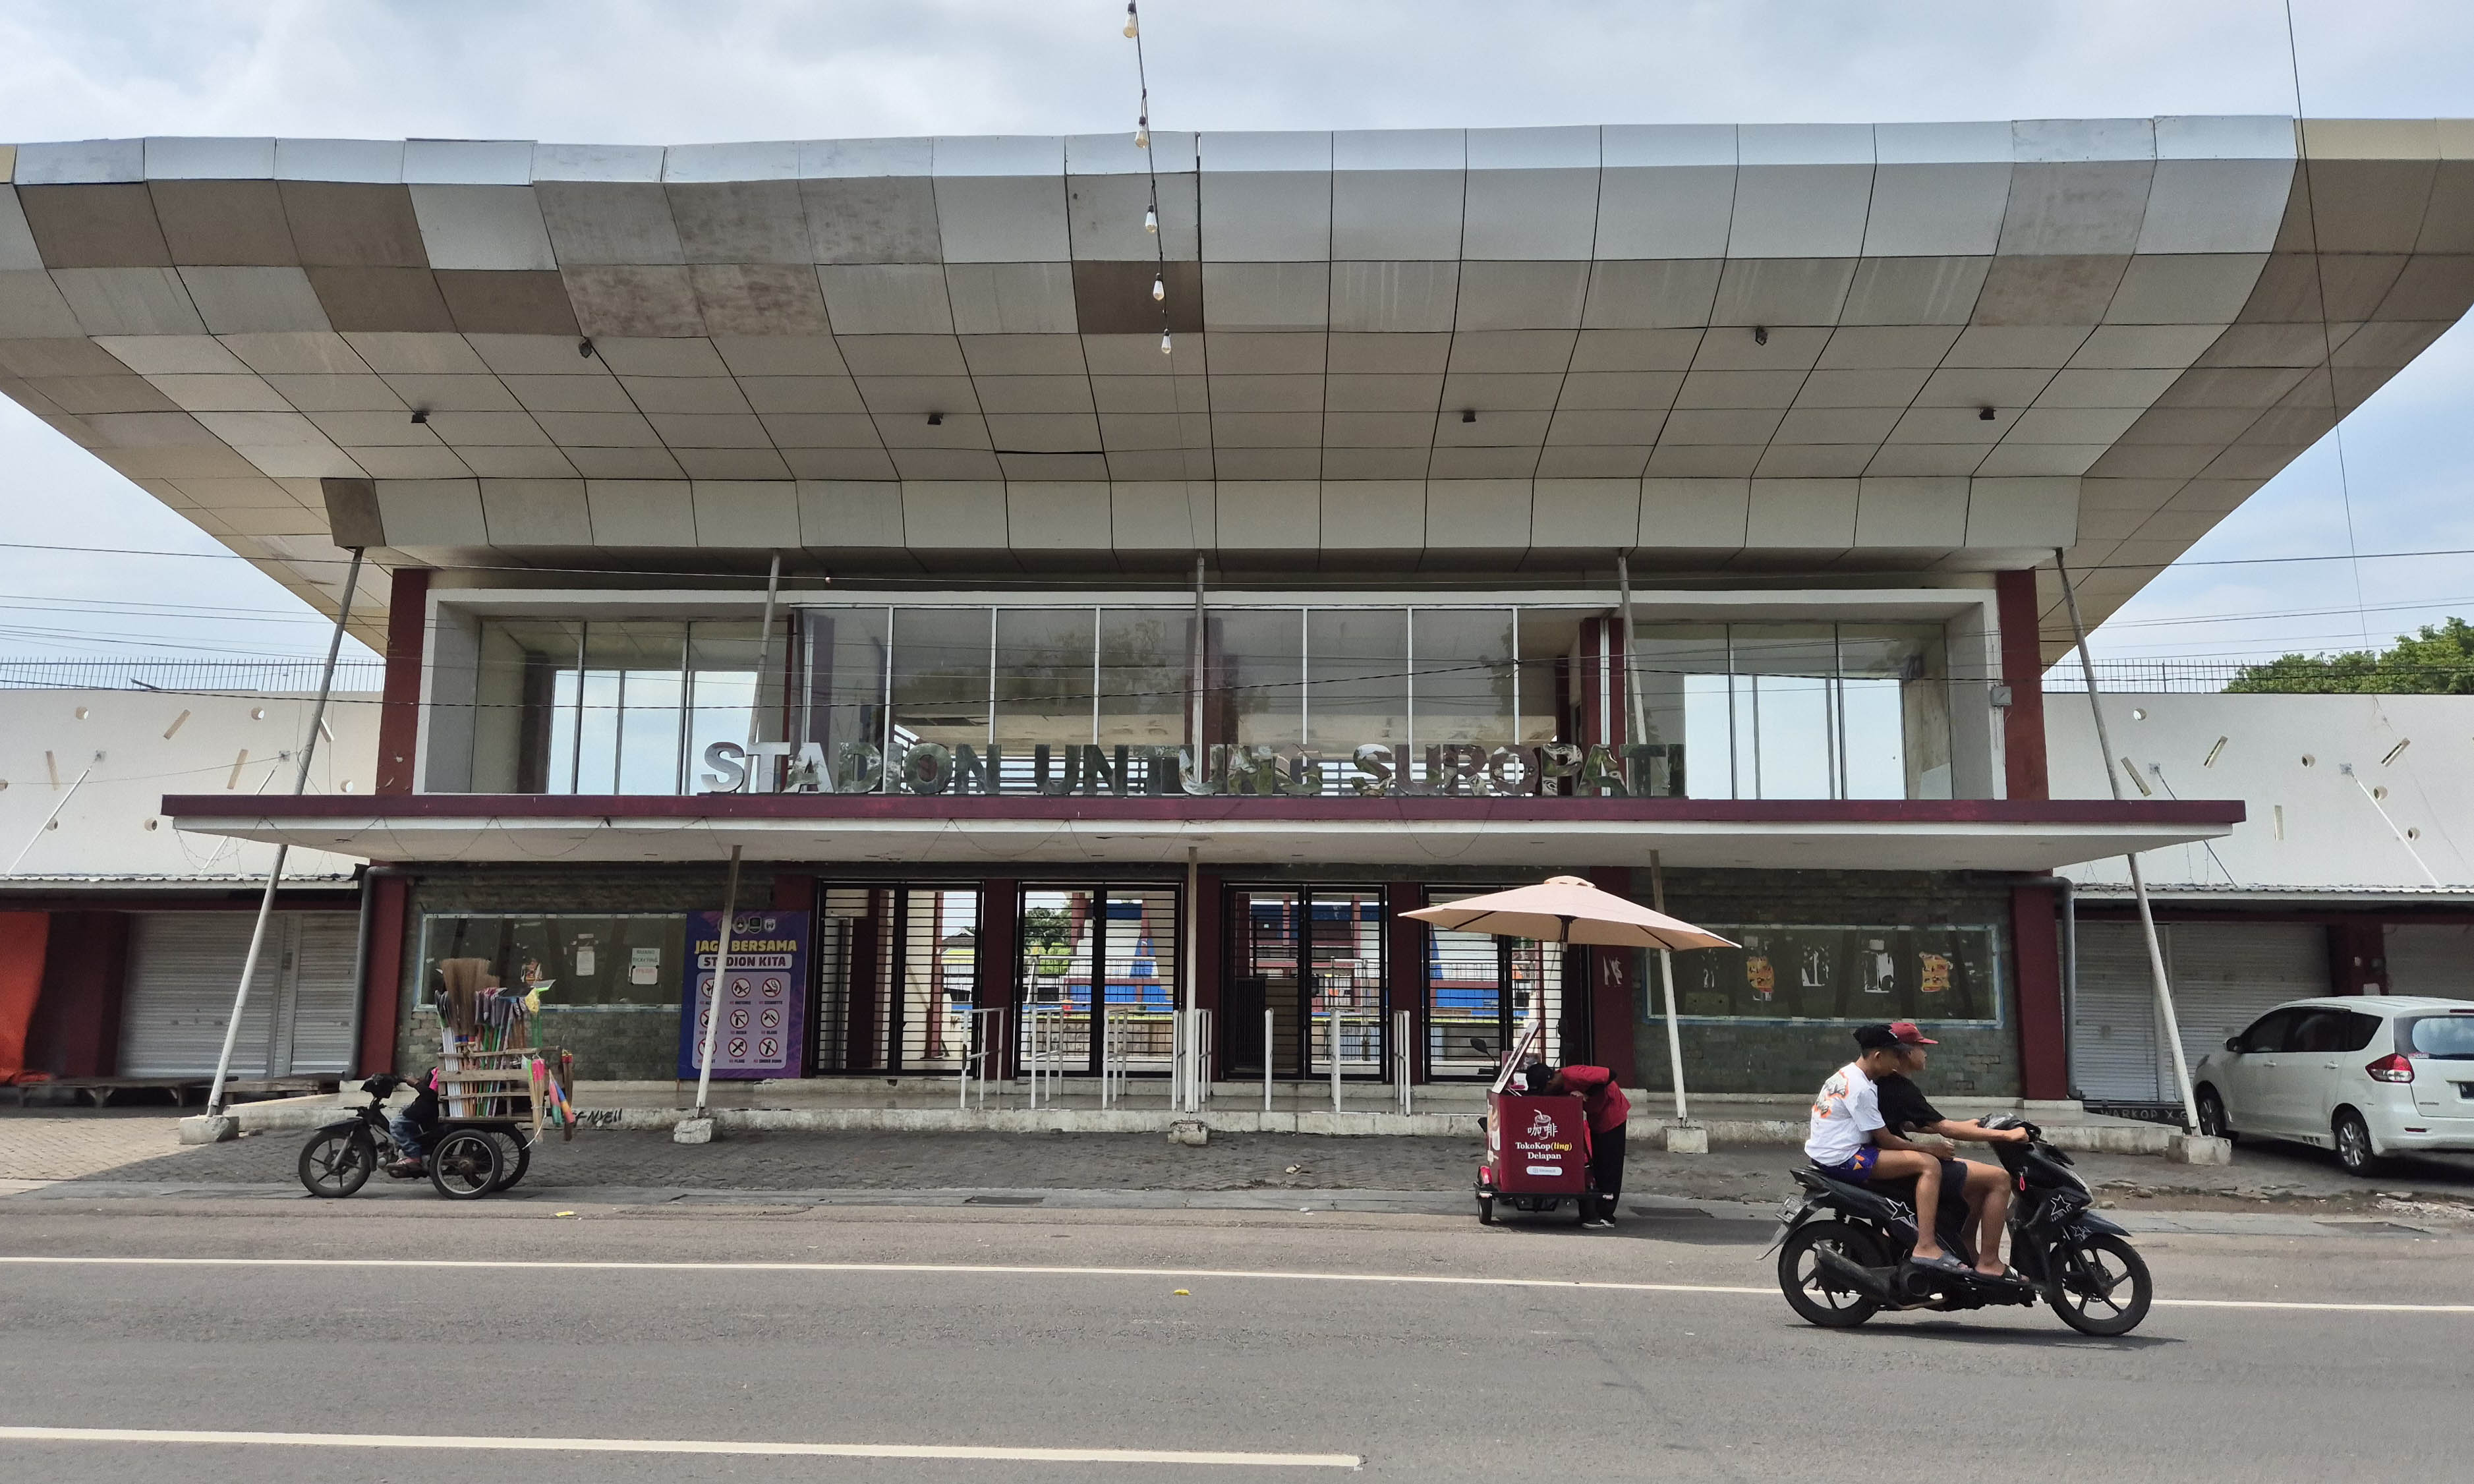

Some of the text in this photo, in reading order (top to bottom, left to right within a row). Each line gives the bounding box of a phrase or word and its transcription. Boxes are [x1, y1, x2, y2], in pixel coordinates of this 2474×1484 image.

[701, 741, 1685, 797] STADION UNTUNG SUROPATI
[695, 940, 797, 954] JAG BERSAMA
[704, 956, 786, 967] STDION KITA
[1515, 1141, 1572, 1152] TokoKop(ling)
[1528, 1152, 1562, 1161] Delapan
